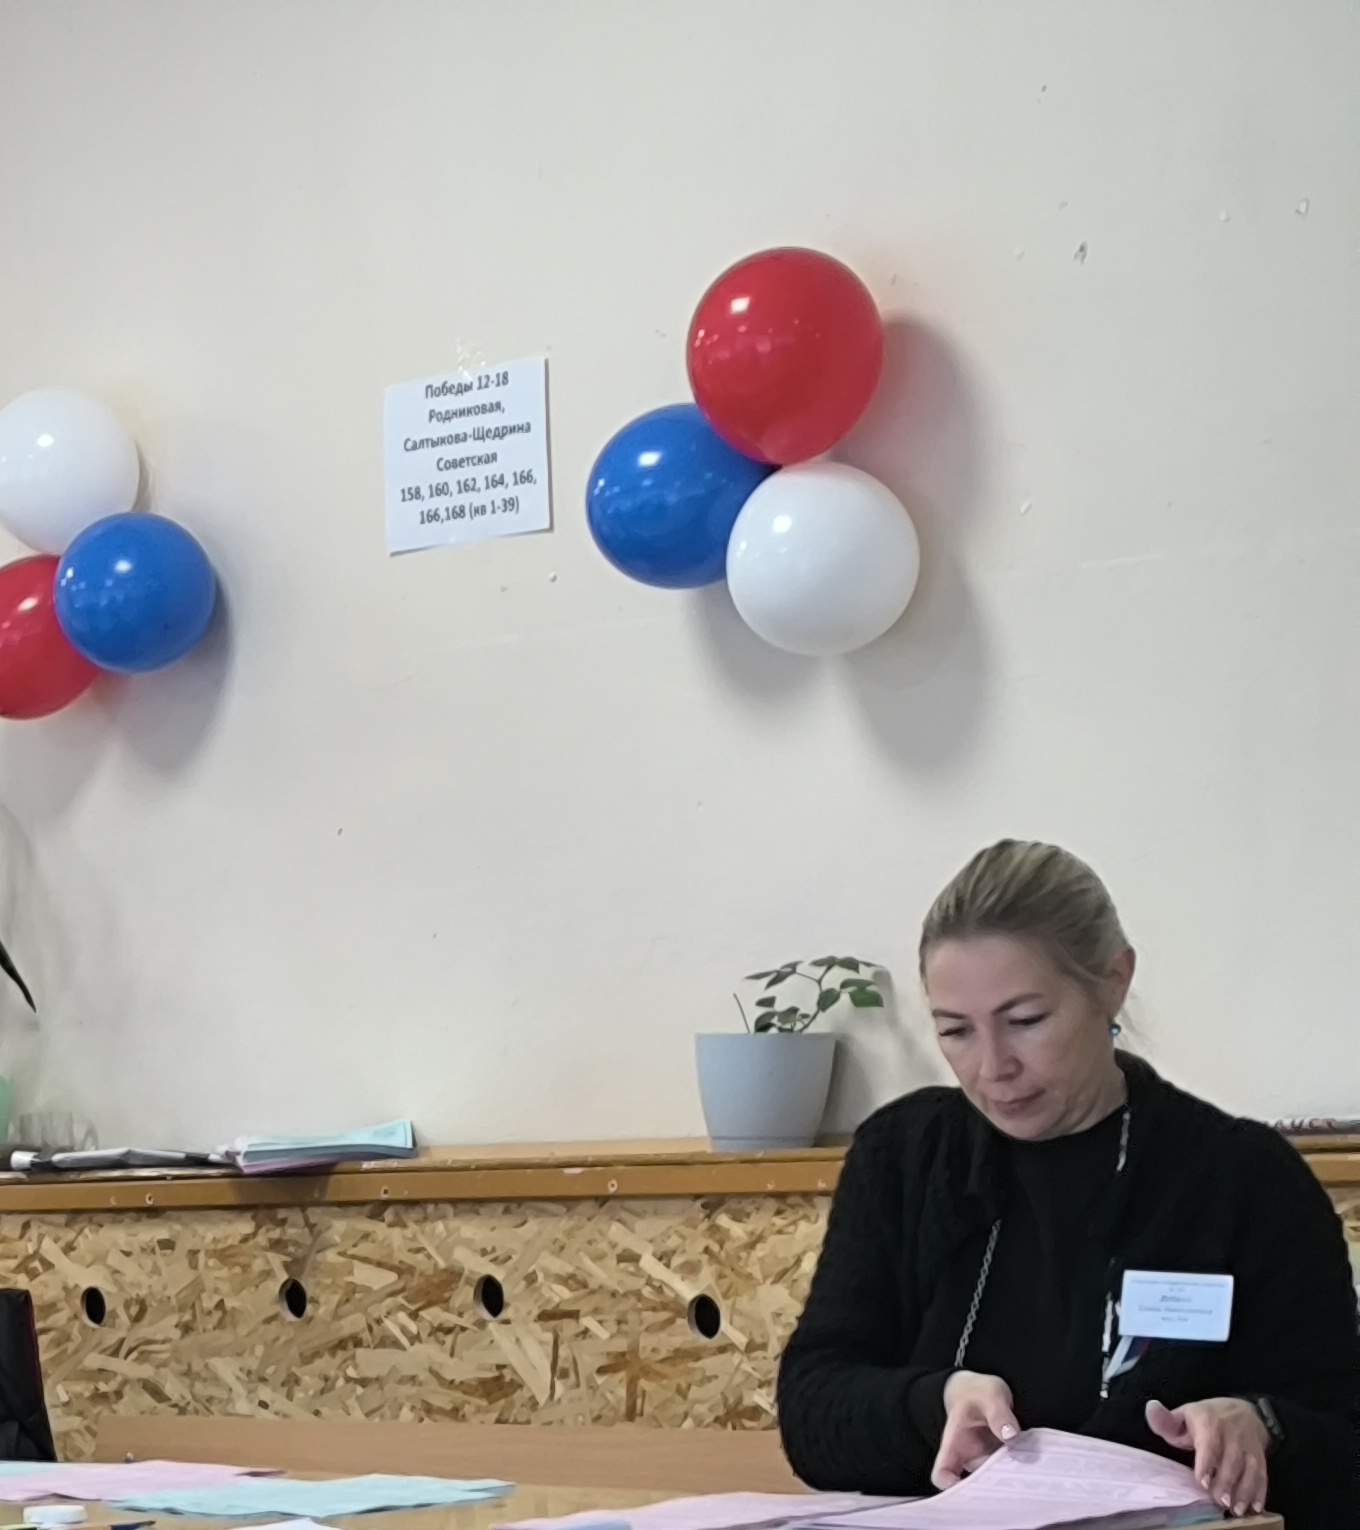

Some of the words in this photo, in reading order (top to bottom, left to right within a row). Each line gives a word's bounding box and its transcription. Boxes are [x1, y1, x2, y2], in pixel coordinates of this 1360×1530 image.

[425, 381, 473, 399] Победы
[477, 371, 509, 390] 12-18
[428, 401, 505, 423] Родниковая,
[404, 422, 531, 452] Салтыкова-Щедрина
[436, 452, 497, 471] Советская
[400, 486, 425, 502] 158,
[428, 482, 453, 499] 160,
[457, 477, 481, 495] 162,
[484, 473, 509, 491] 164,
